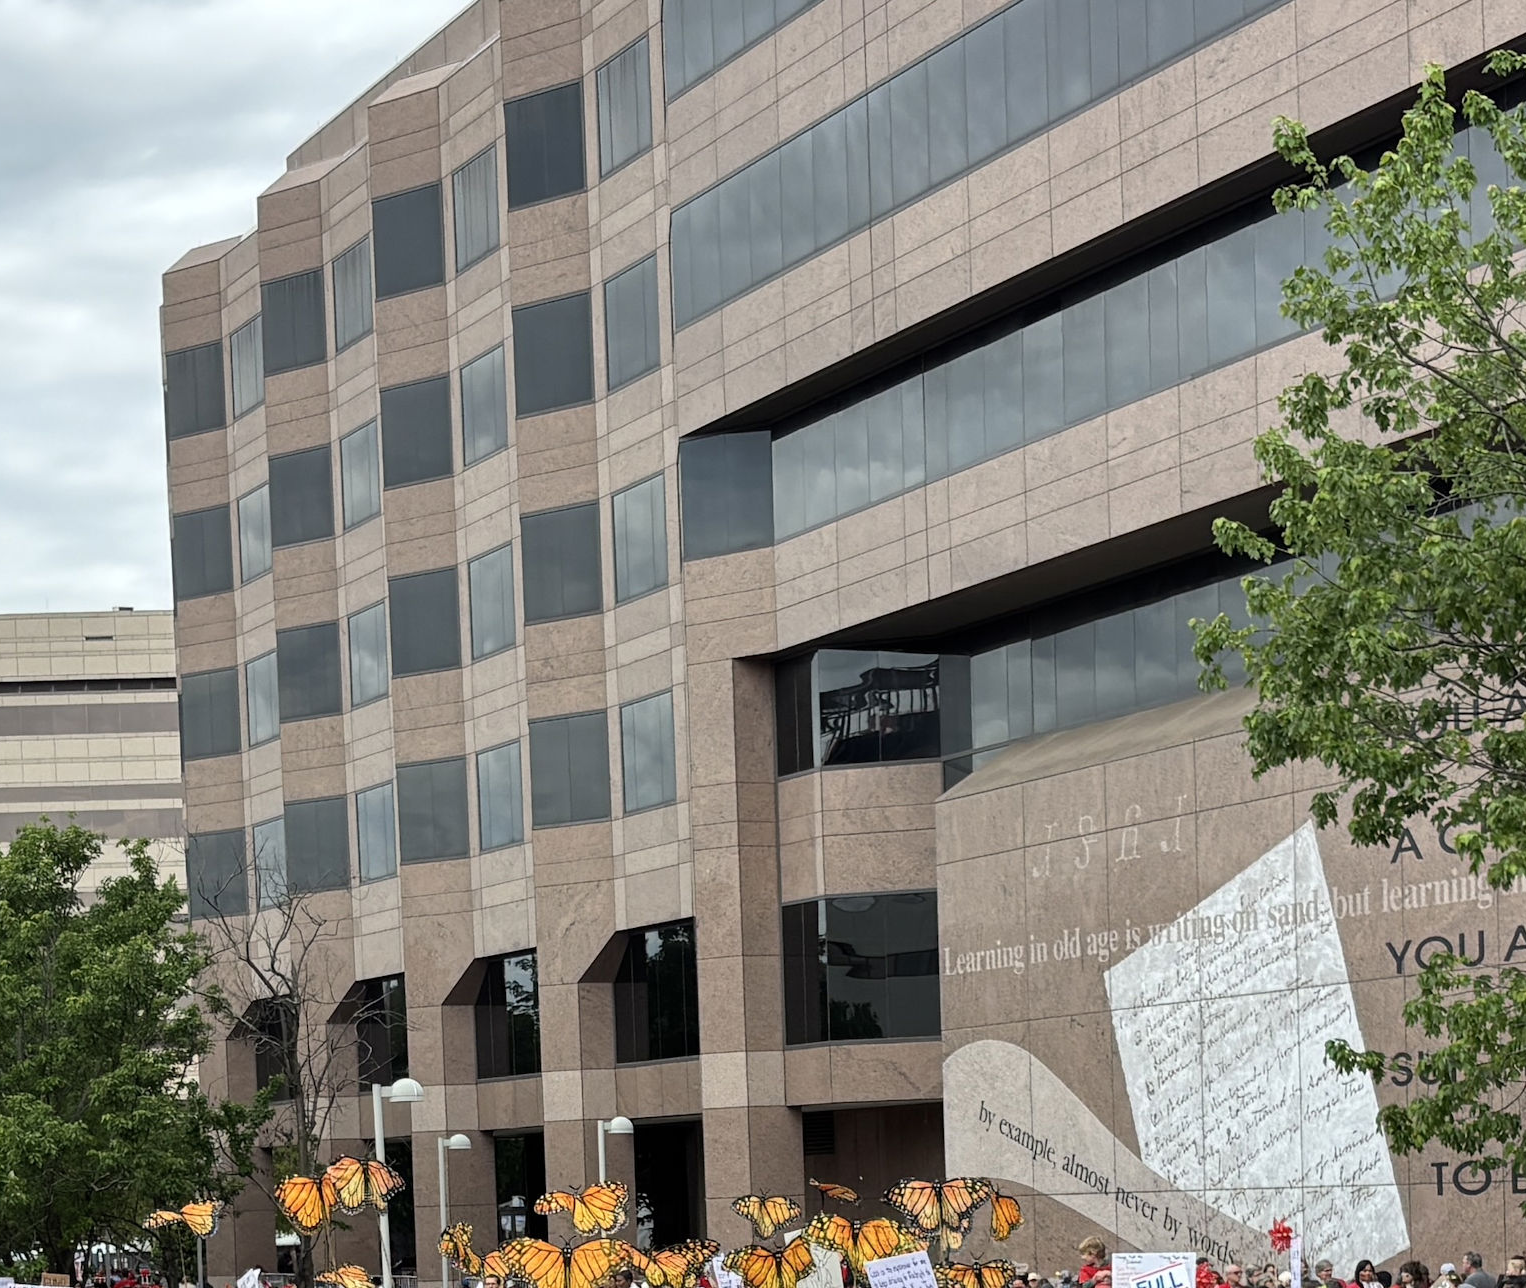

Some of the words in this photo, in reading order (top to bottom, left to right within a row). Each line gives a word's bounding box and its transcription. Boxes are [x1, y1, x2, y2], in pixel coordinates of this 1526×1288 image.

[943, 941, 1025, 979] Learning
[1031, 933, 1048, 963] in
[1054, 926, 1082, 960] old
[1087, 928, 1120, 963] age
[1126, 919, 1141, 948] is
[1149, 908, 1225, 946] writing
[1233, 910, 1259, 934] on
[1333, 886, 1371, 920] but
[1382, 867, 1495, 915] learning
[1385, 930, 1486, 975] YOU
[978, 1100, 996, 1132] by
[999, 1115, 1057, 1171] example,
[1061, 1151, 1110, 1197] almost
[1115, 1184, 1159, 1225] never
[1163, 1207, 1182, 1241] by
[1431, 1161, 1493, 1197] TO
